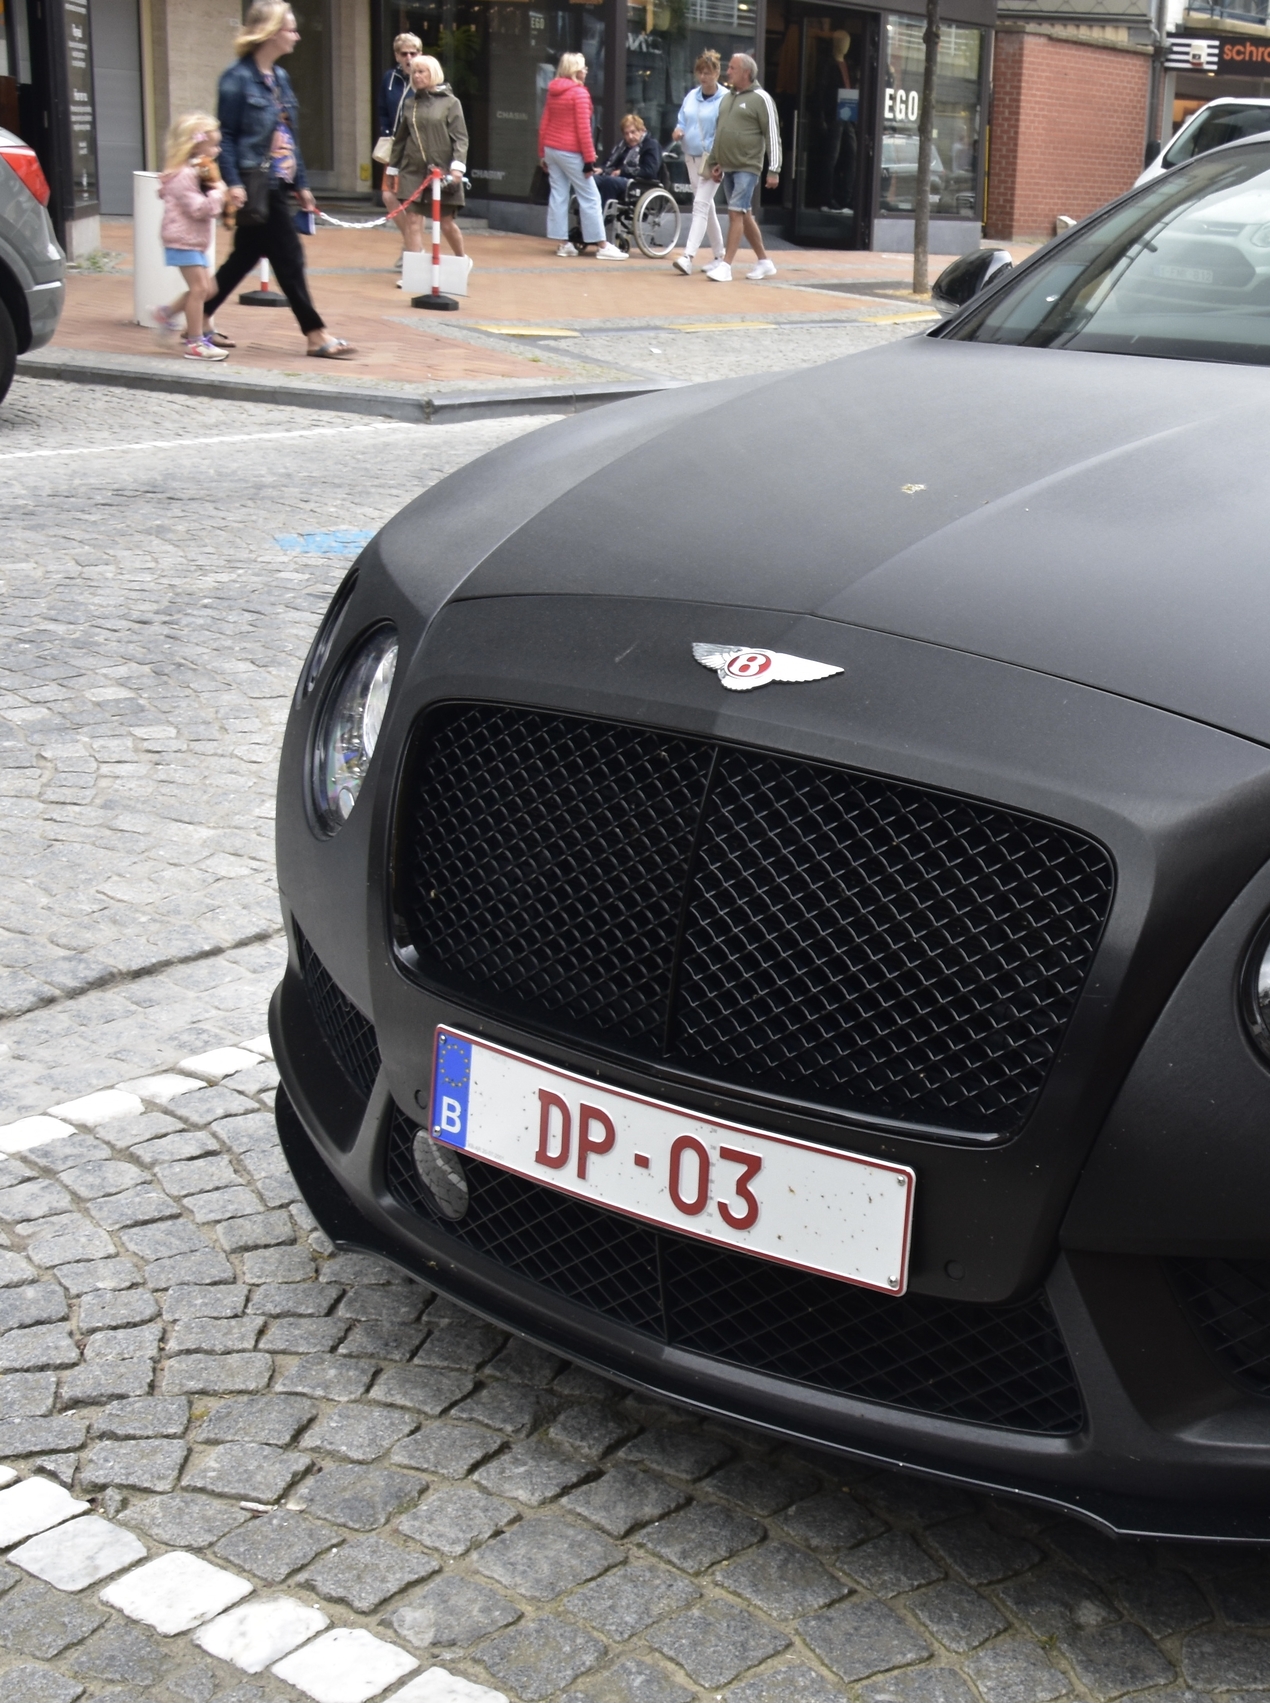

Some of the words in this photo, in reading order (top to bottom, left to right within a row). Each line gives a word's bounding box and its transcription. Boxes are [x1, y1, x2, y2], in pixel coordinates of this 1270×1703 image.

[884, 88, 919, 121] EGO
[441, 1095, 462, 1134] B
[534, 1088, 762, 1231] DP-03
